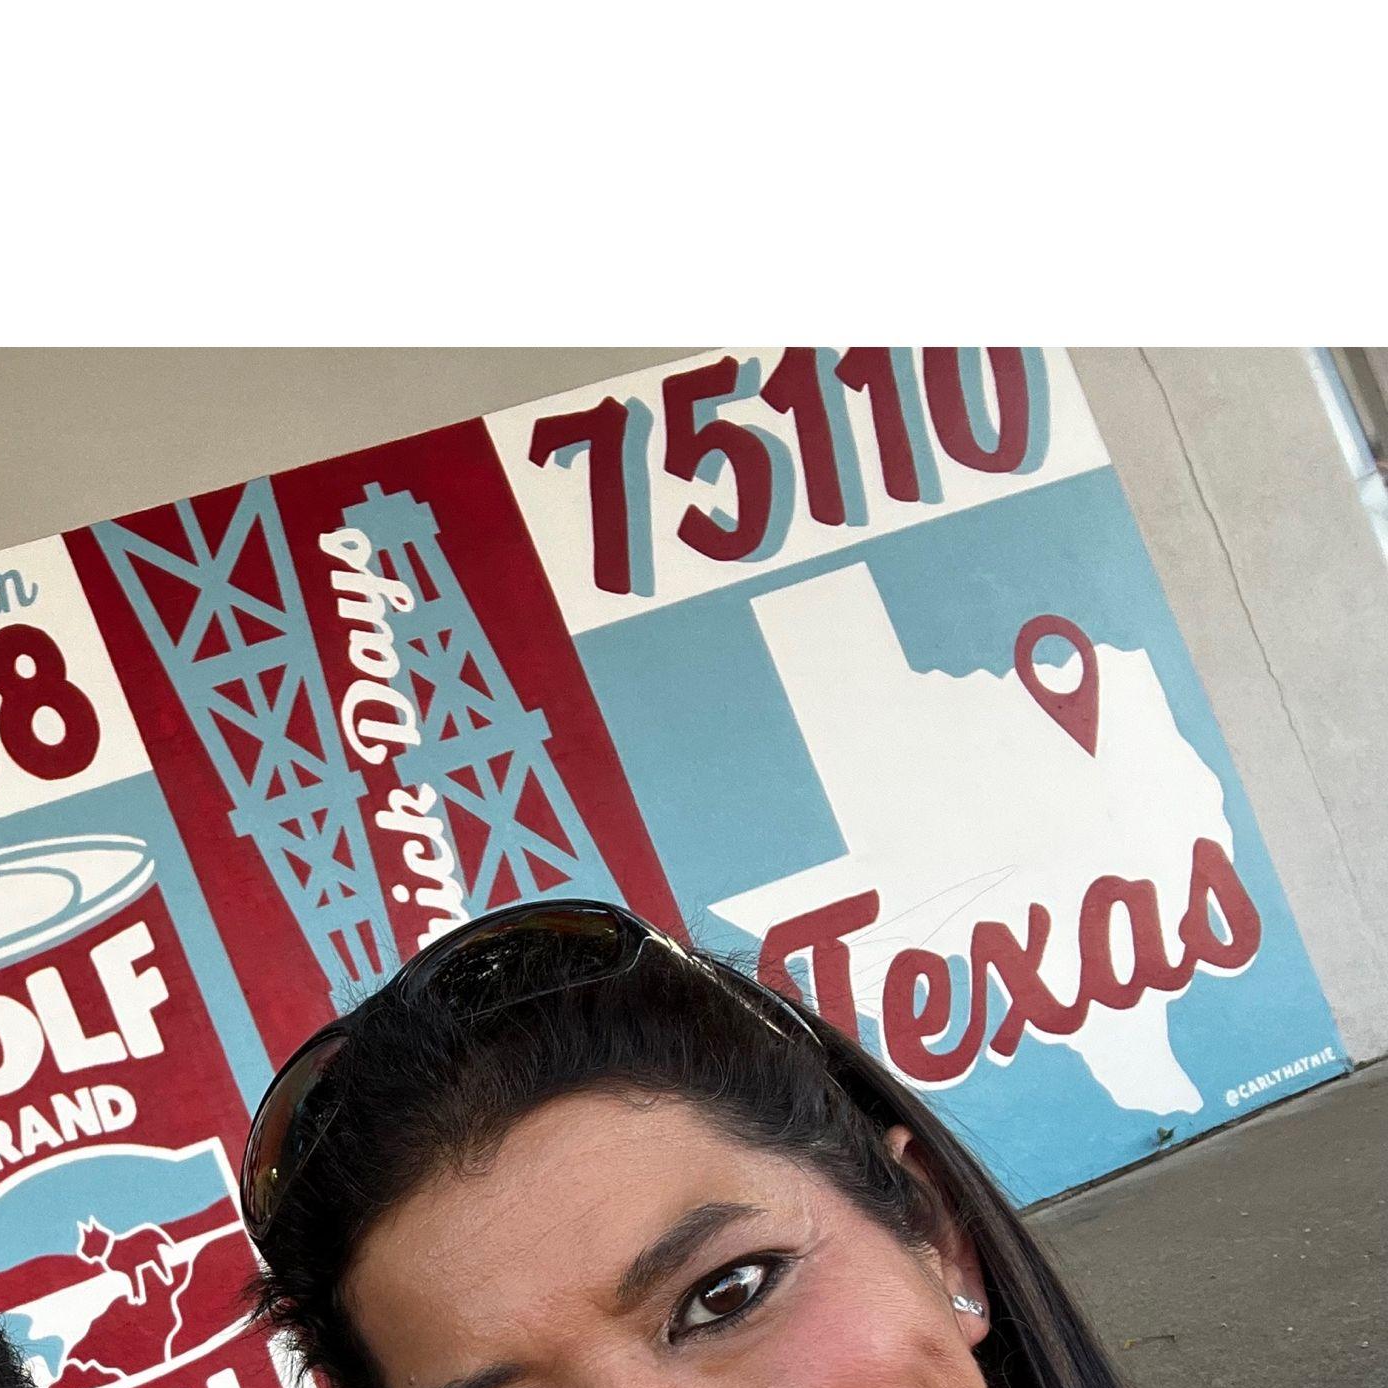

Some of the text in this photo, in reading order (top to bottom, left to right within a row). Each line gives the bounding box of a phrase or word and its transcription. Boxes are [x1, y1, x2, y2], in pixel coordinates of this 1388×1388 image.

[529, 348, 1050, 598] 75110
[319, 528, 421, 765] Days
[757, 837, 1262, 1085] Texas
